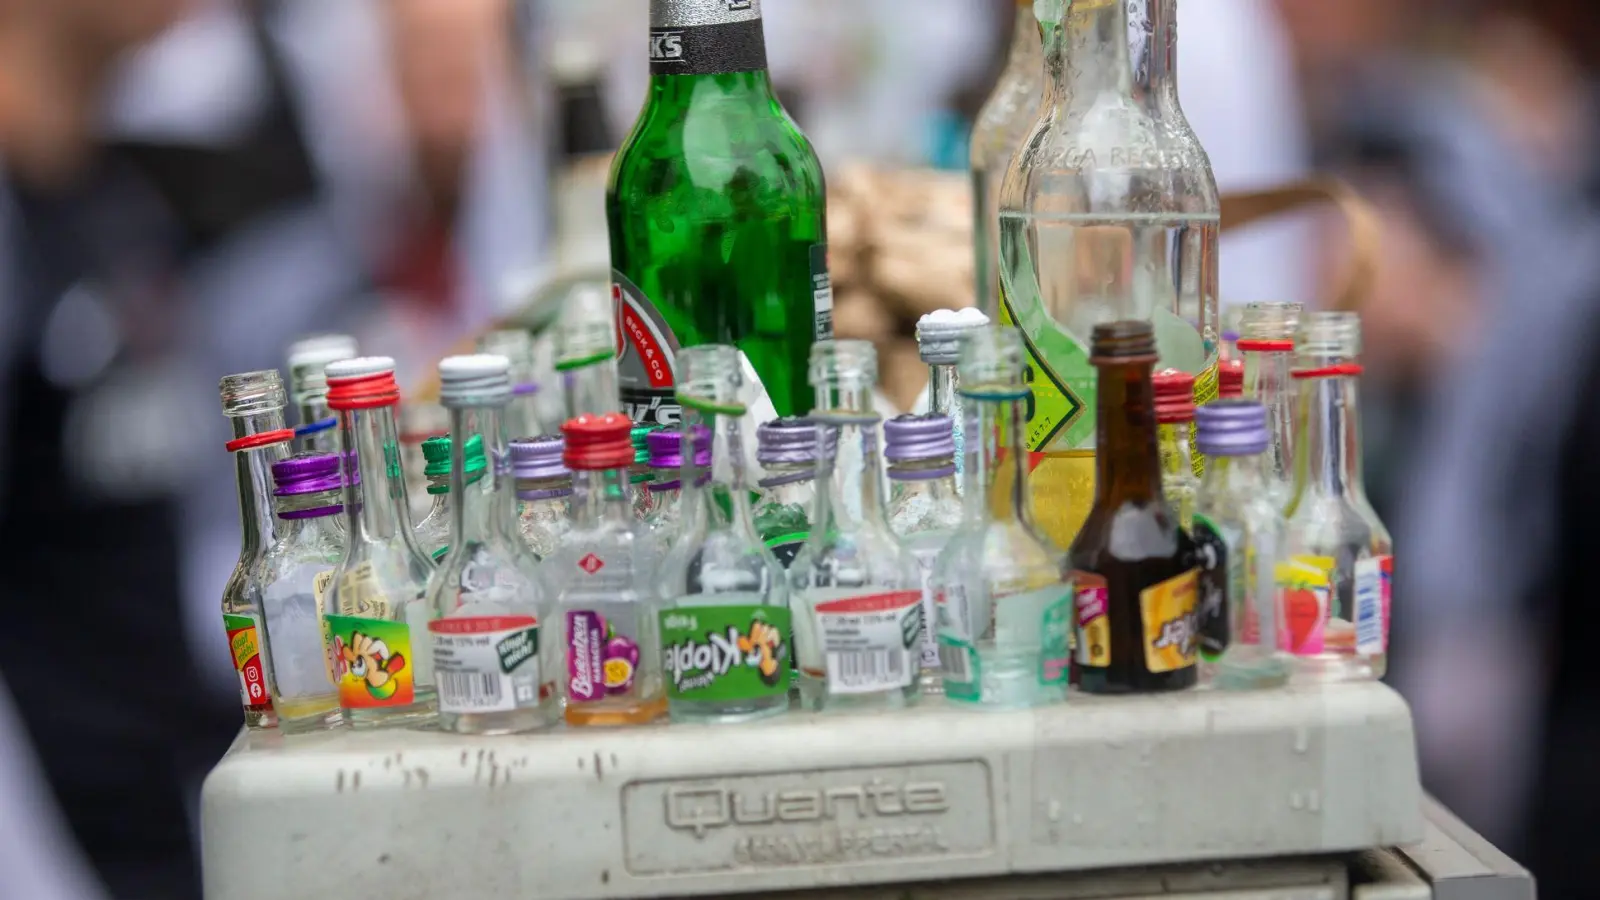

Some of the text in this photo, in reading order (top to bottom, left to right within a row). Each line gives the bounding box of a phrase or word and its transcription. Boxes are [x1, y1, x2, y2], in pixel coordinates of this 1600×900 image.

[625, 315, 648, 347] BECK
[651, 359, 664, 381] CO
[570, 615, 594, 699] Berentzen
[664, 777, 951, 839] Quante
